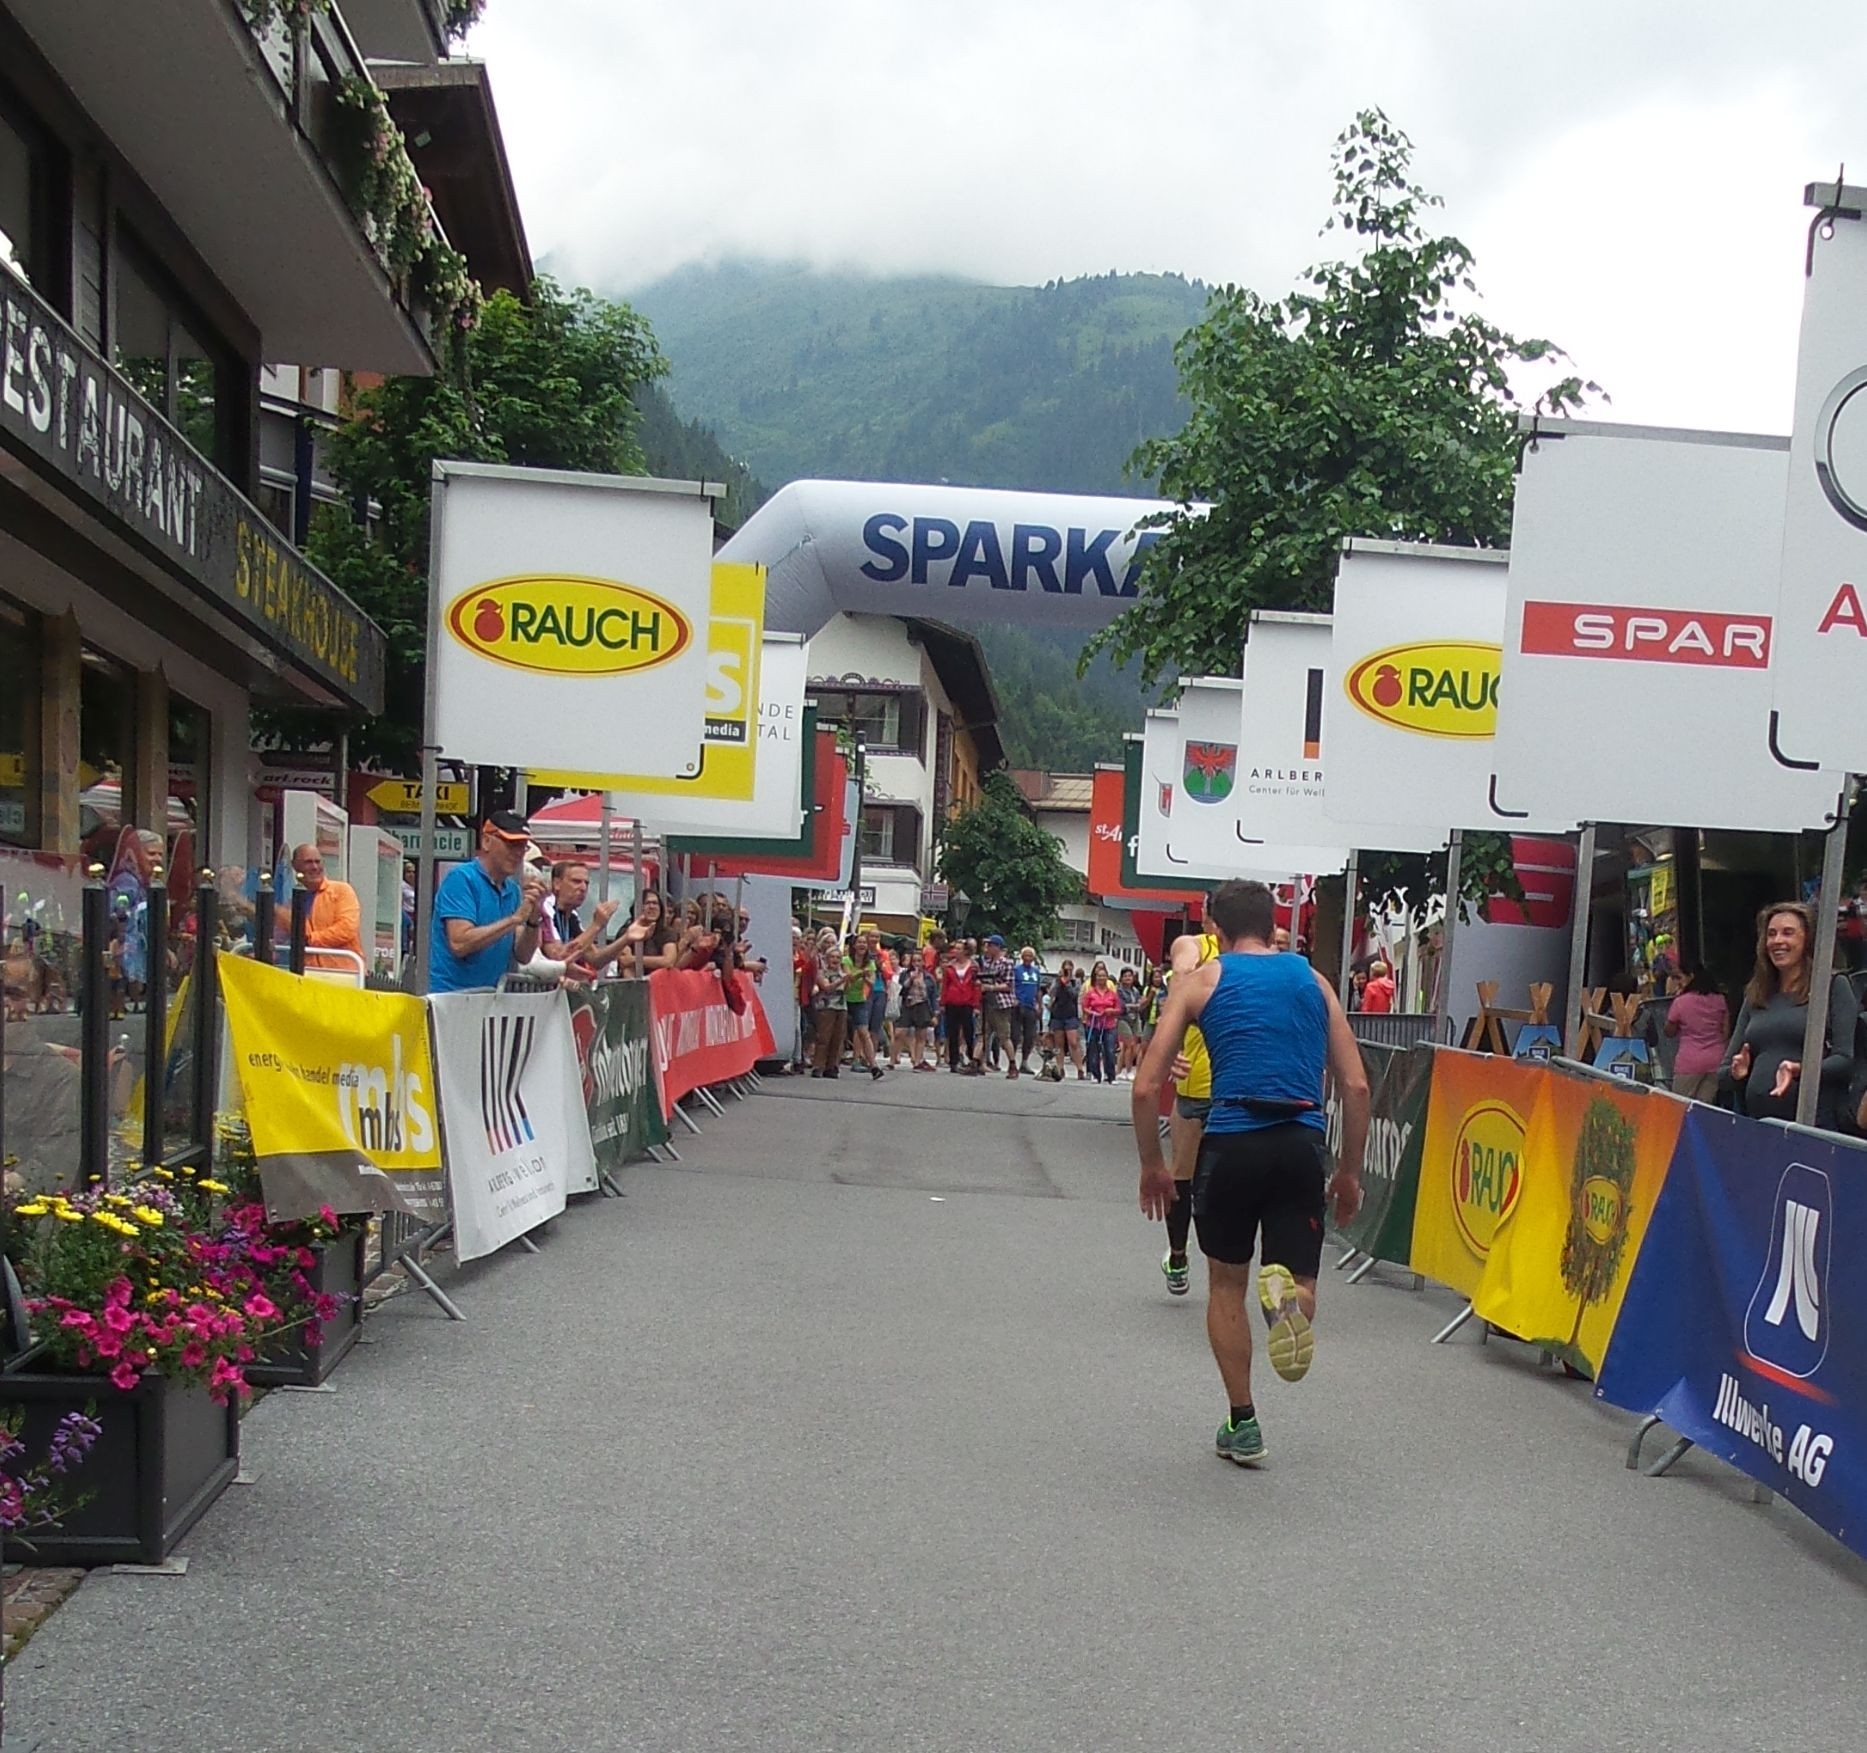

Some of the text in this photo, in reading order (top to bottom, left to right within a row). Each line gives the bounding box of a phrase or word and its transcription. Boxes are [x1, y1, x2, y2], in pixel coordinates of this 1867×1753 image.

[511, 602, 660, 652] RAUCH
[1572, 614, 1767, 660] SPAR
[263, 774, 332, 785] arl.rock
[1249, 785, 1282, 794] Center
[1286, 786, 1300, 796] für
[301, 1065, 331, 1086] handel
[332, 1069, 359, 1088] media
[1712, 1373, 1834, 1487] Illwerke AG
